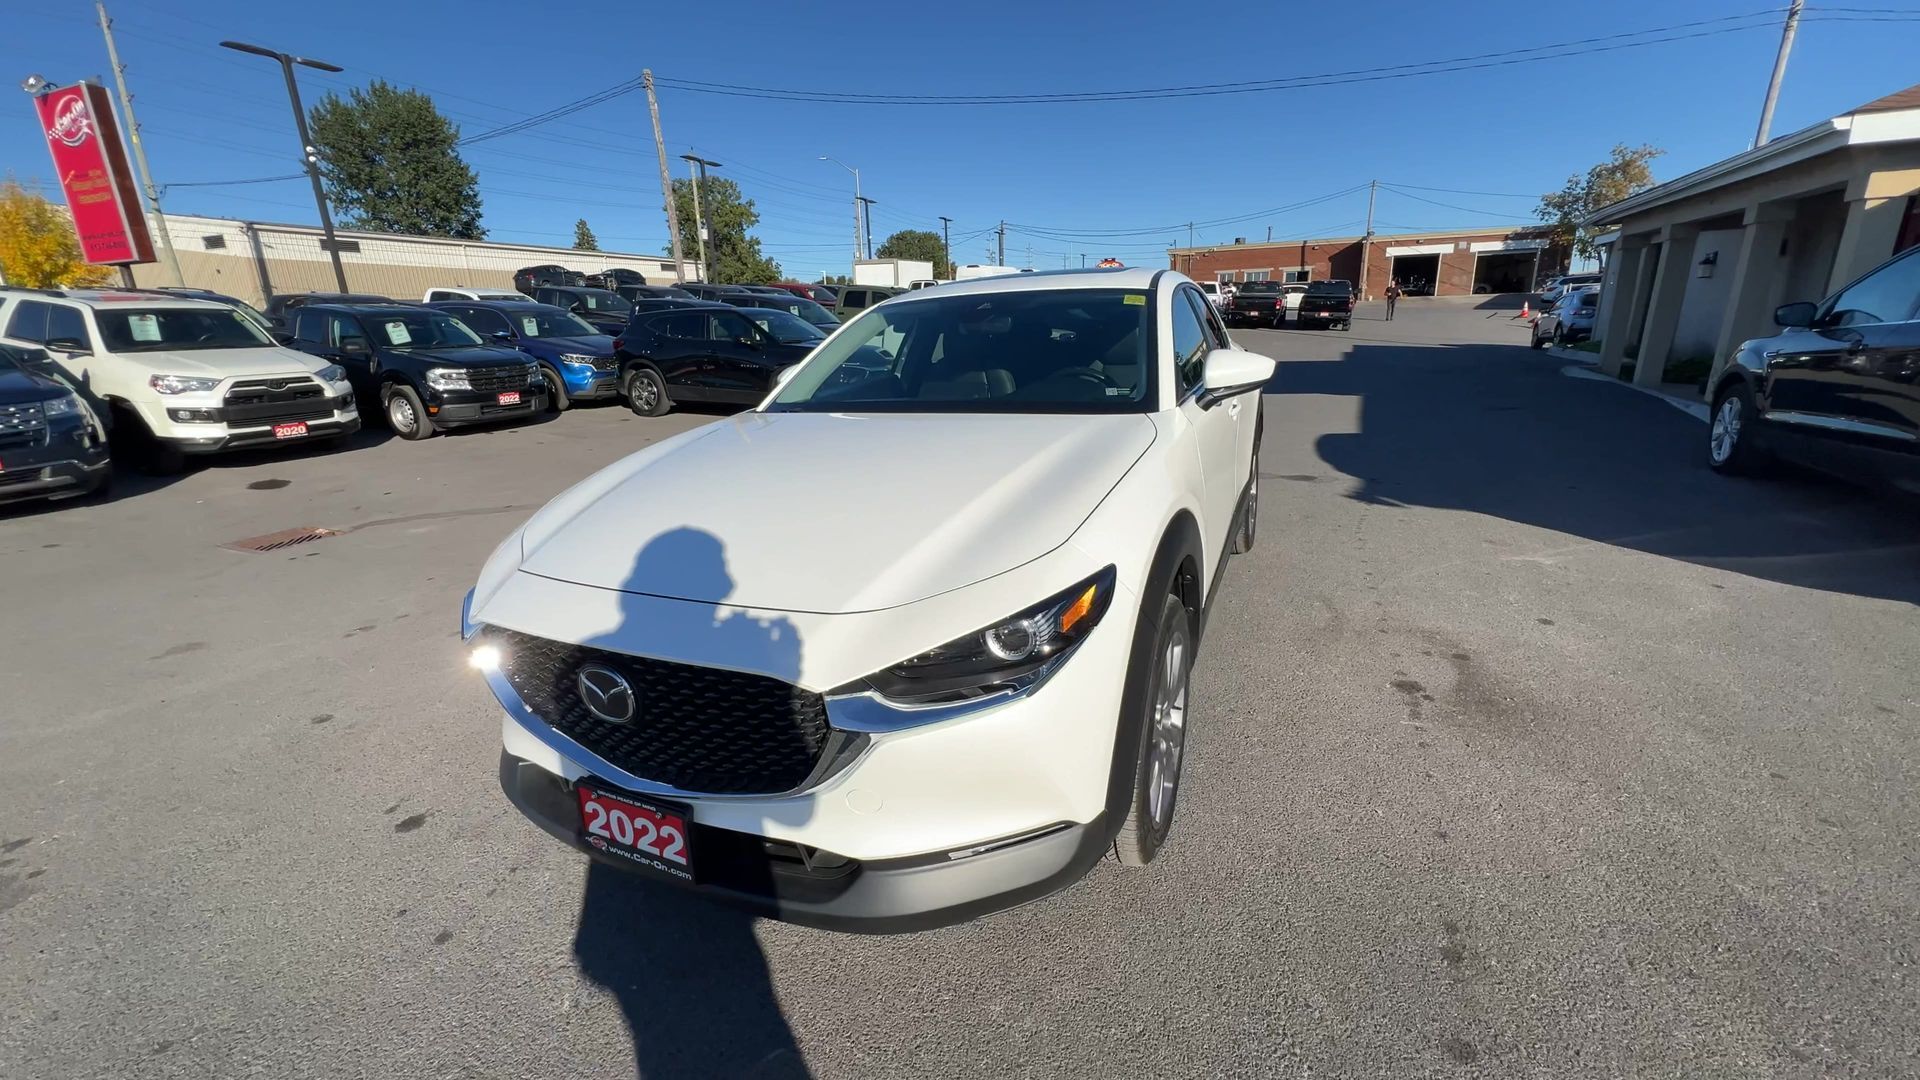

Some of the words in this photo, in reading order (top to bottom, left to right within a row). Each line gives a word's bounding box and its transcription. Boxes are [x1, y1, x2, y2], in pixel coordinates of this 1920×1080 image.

[499, 394, 520, 403] 2022
[276, 425, 307, 436] 2020
[585, 801, 687, 865] 2022
[608, 845, 692, 880] www.Car-On.com
